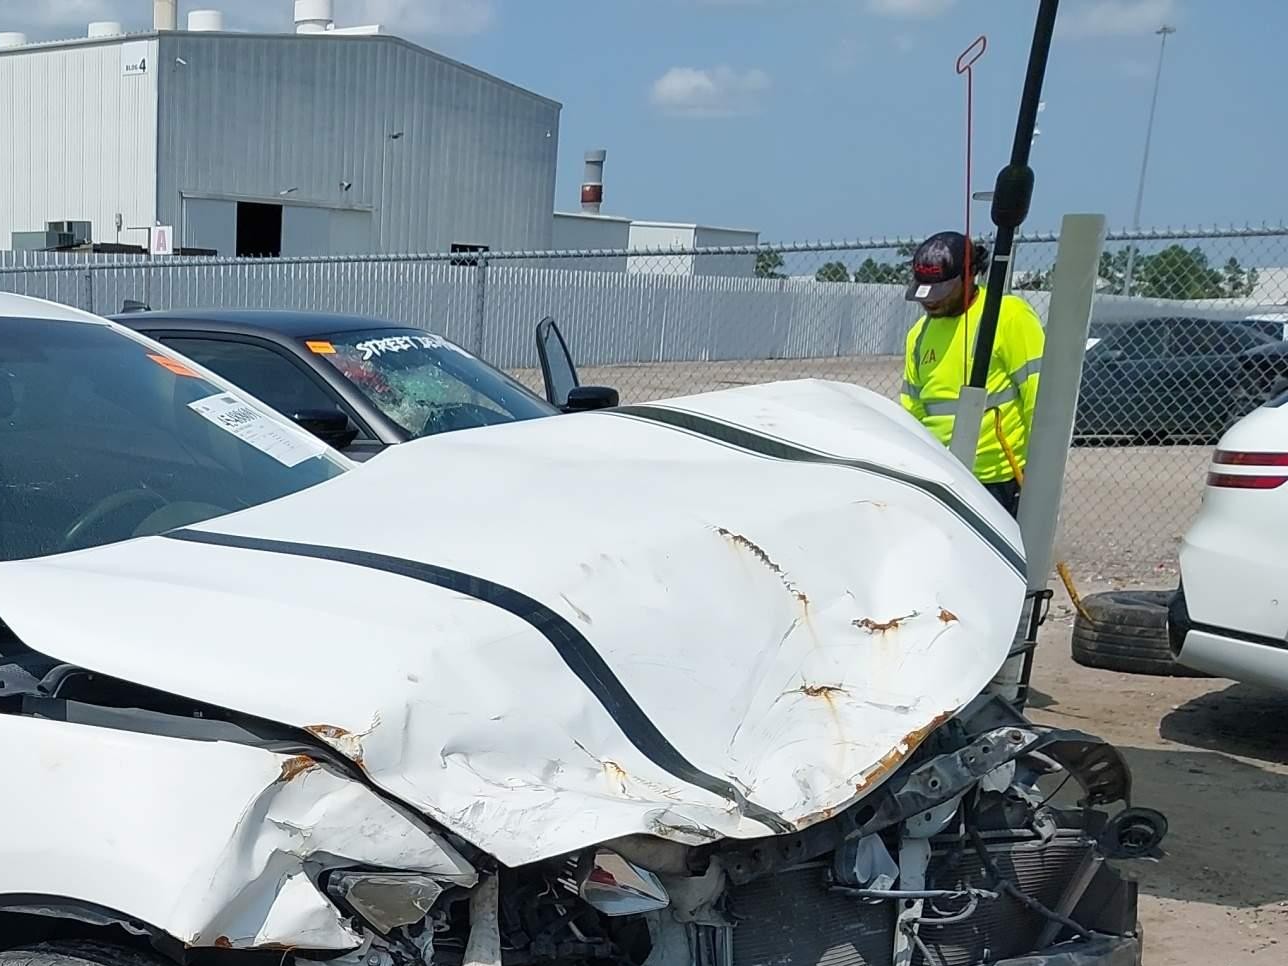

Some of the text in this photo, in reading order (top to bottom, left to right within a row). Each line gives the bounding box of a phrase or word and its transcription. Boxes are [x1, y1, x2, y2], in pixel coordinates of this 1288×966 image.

[139, 58, 146, 72] 4
[156, 230, 167, 251] A
[356, 336, 418, 360] STREET
